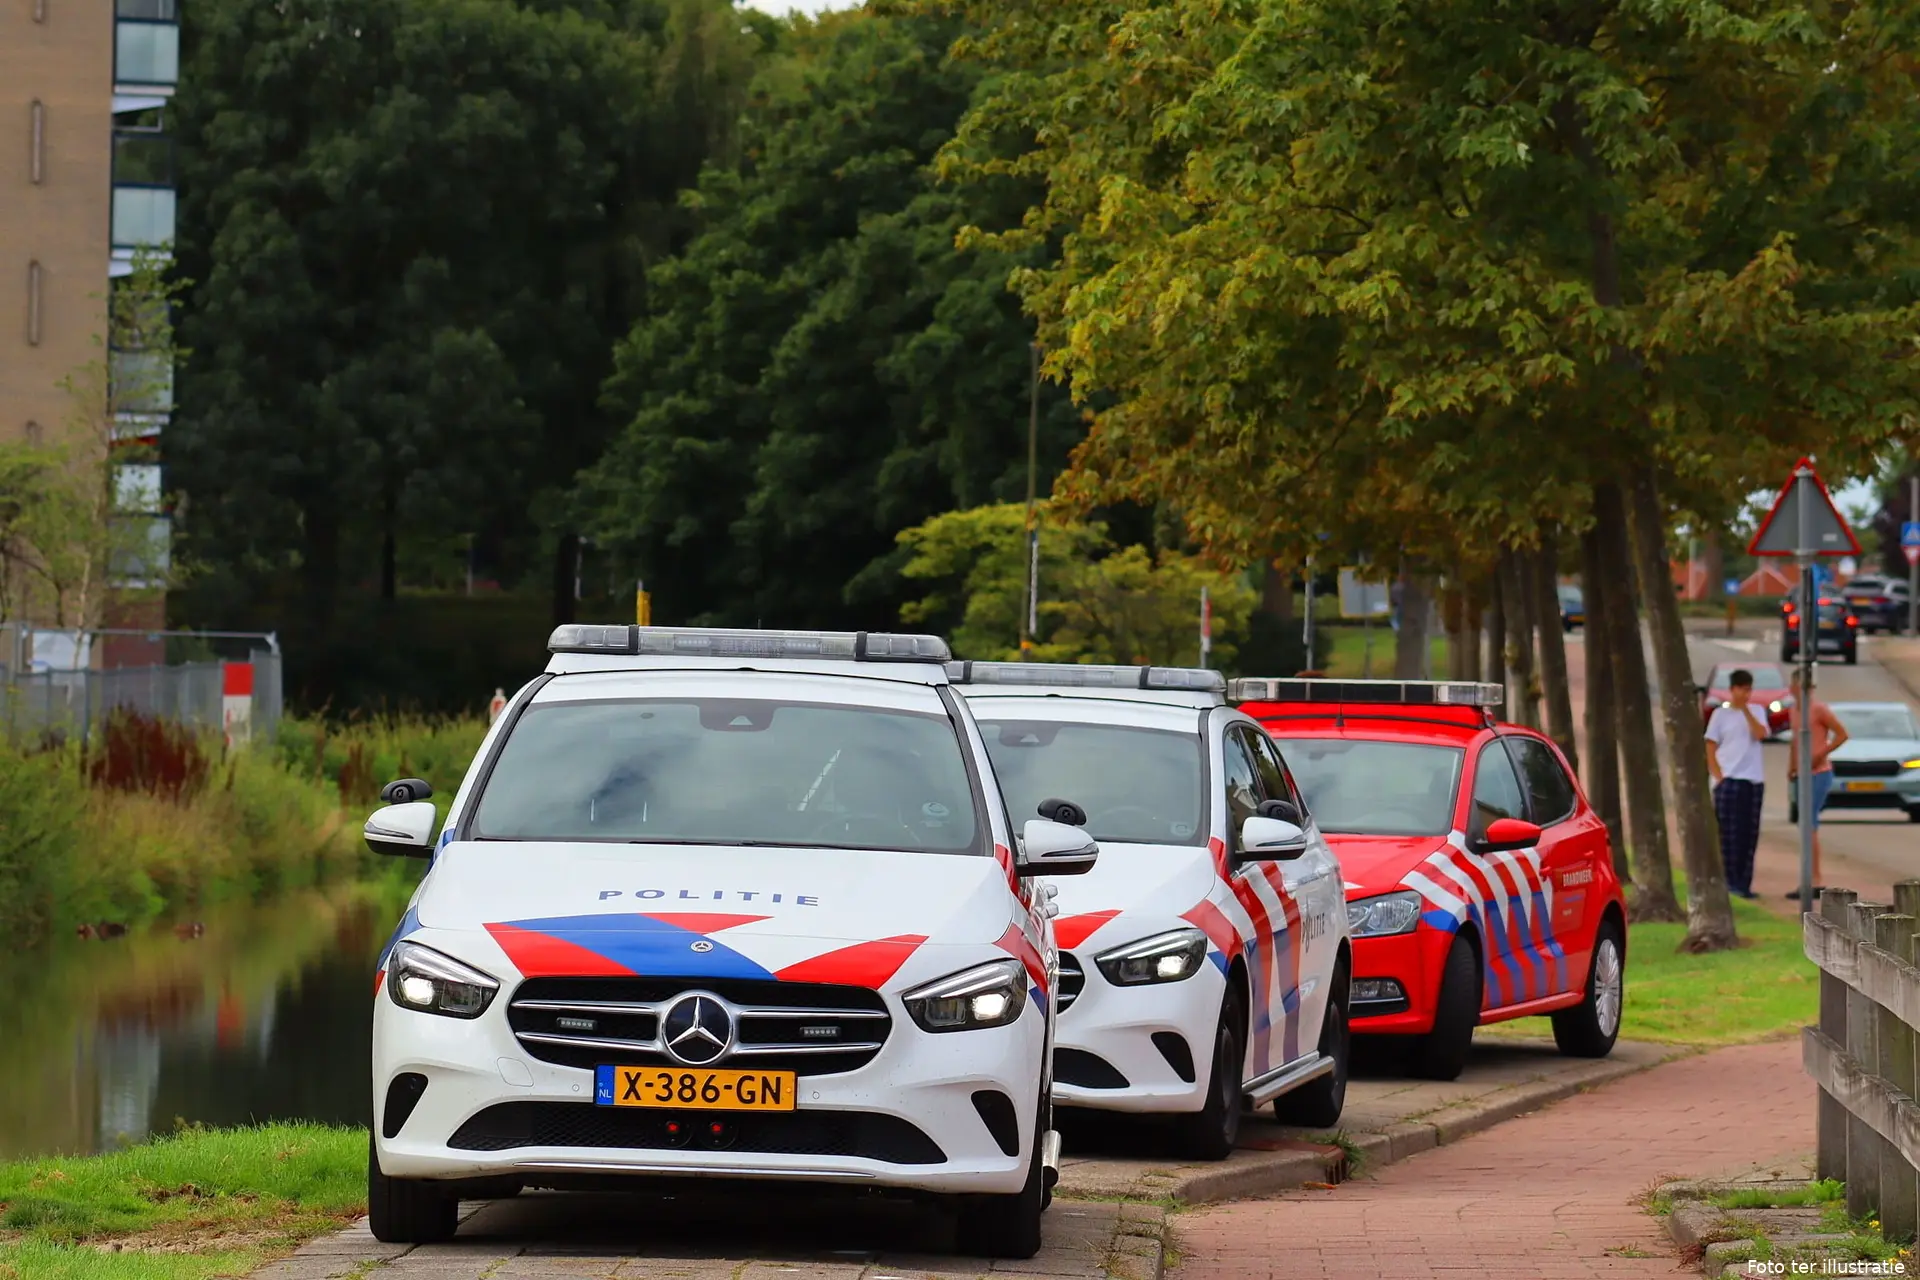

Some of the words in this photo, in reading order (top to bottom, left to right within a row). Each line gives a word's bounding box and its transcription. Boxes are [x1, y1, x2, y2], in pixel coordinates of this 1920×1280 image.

[599, 889, 819, 907] POLITIE
[598, 1089, 612, 1099] NL
[623, 1071, 782, 1105] X-386-GN
